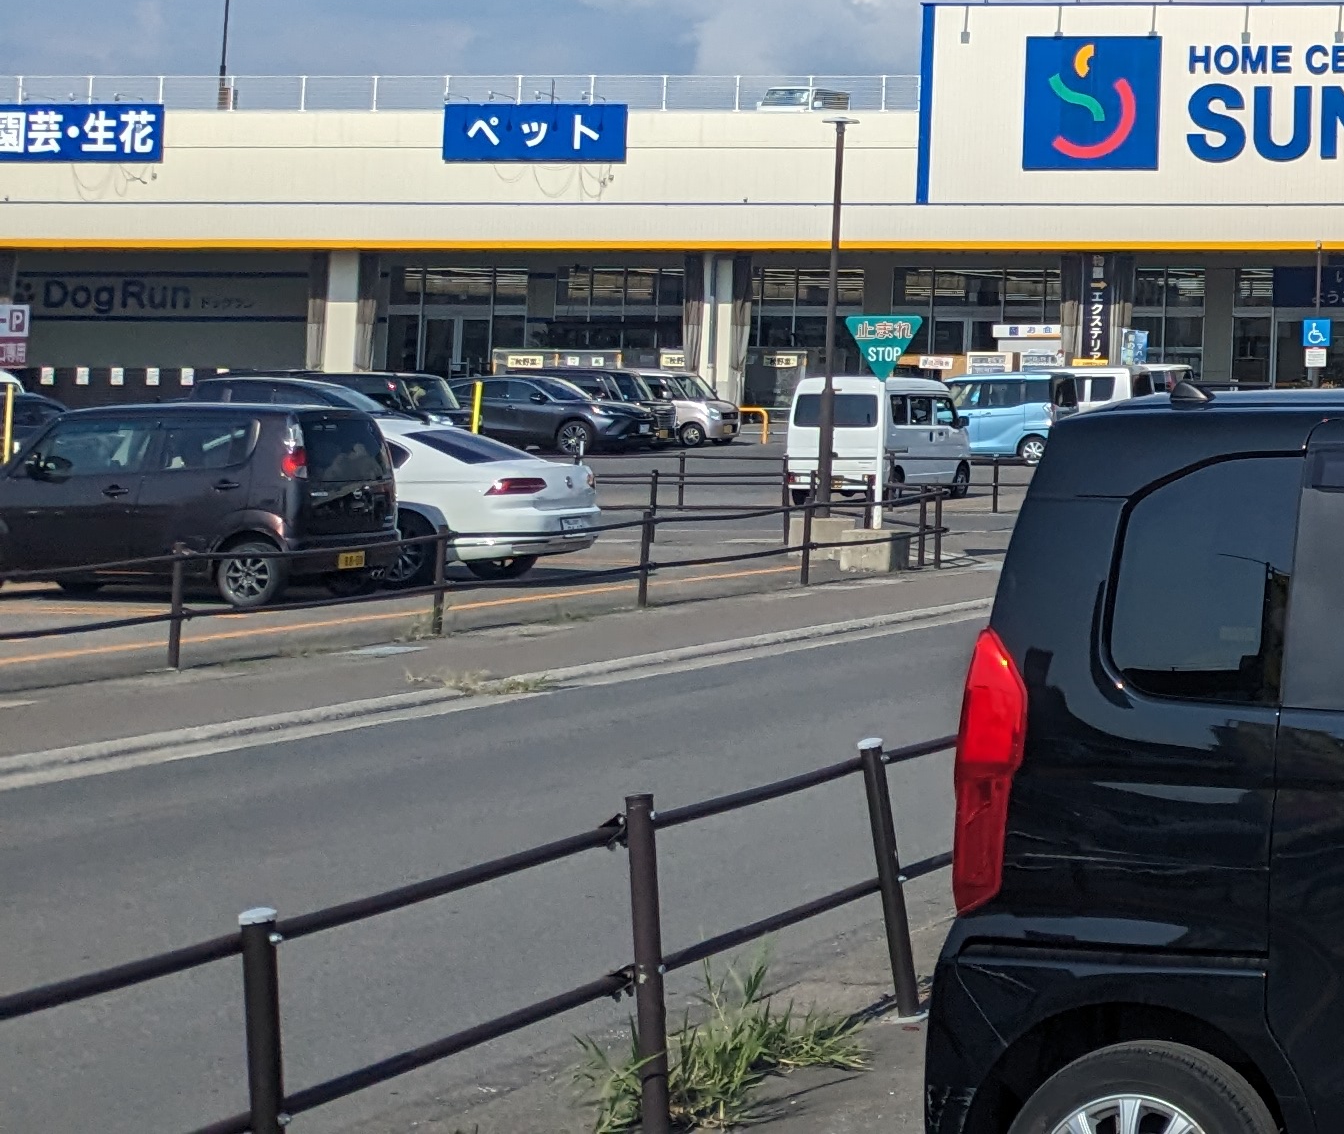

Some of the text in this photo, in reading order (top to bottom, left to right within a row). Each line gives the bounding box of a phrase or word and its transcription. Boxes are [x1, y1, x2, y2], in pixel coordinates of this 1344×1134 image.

[1188, 45, 1292, 74] HOME
[467, 114, 600, 150] ペット
[43, 280, 191, 314] Dog Run
[855, 321, 914, 340] 止まれ
[1089, 291, 1104, 360] エクステリア
[867, 347, 902, 362] STOP
